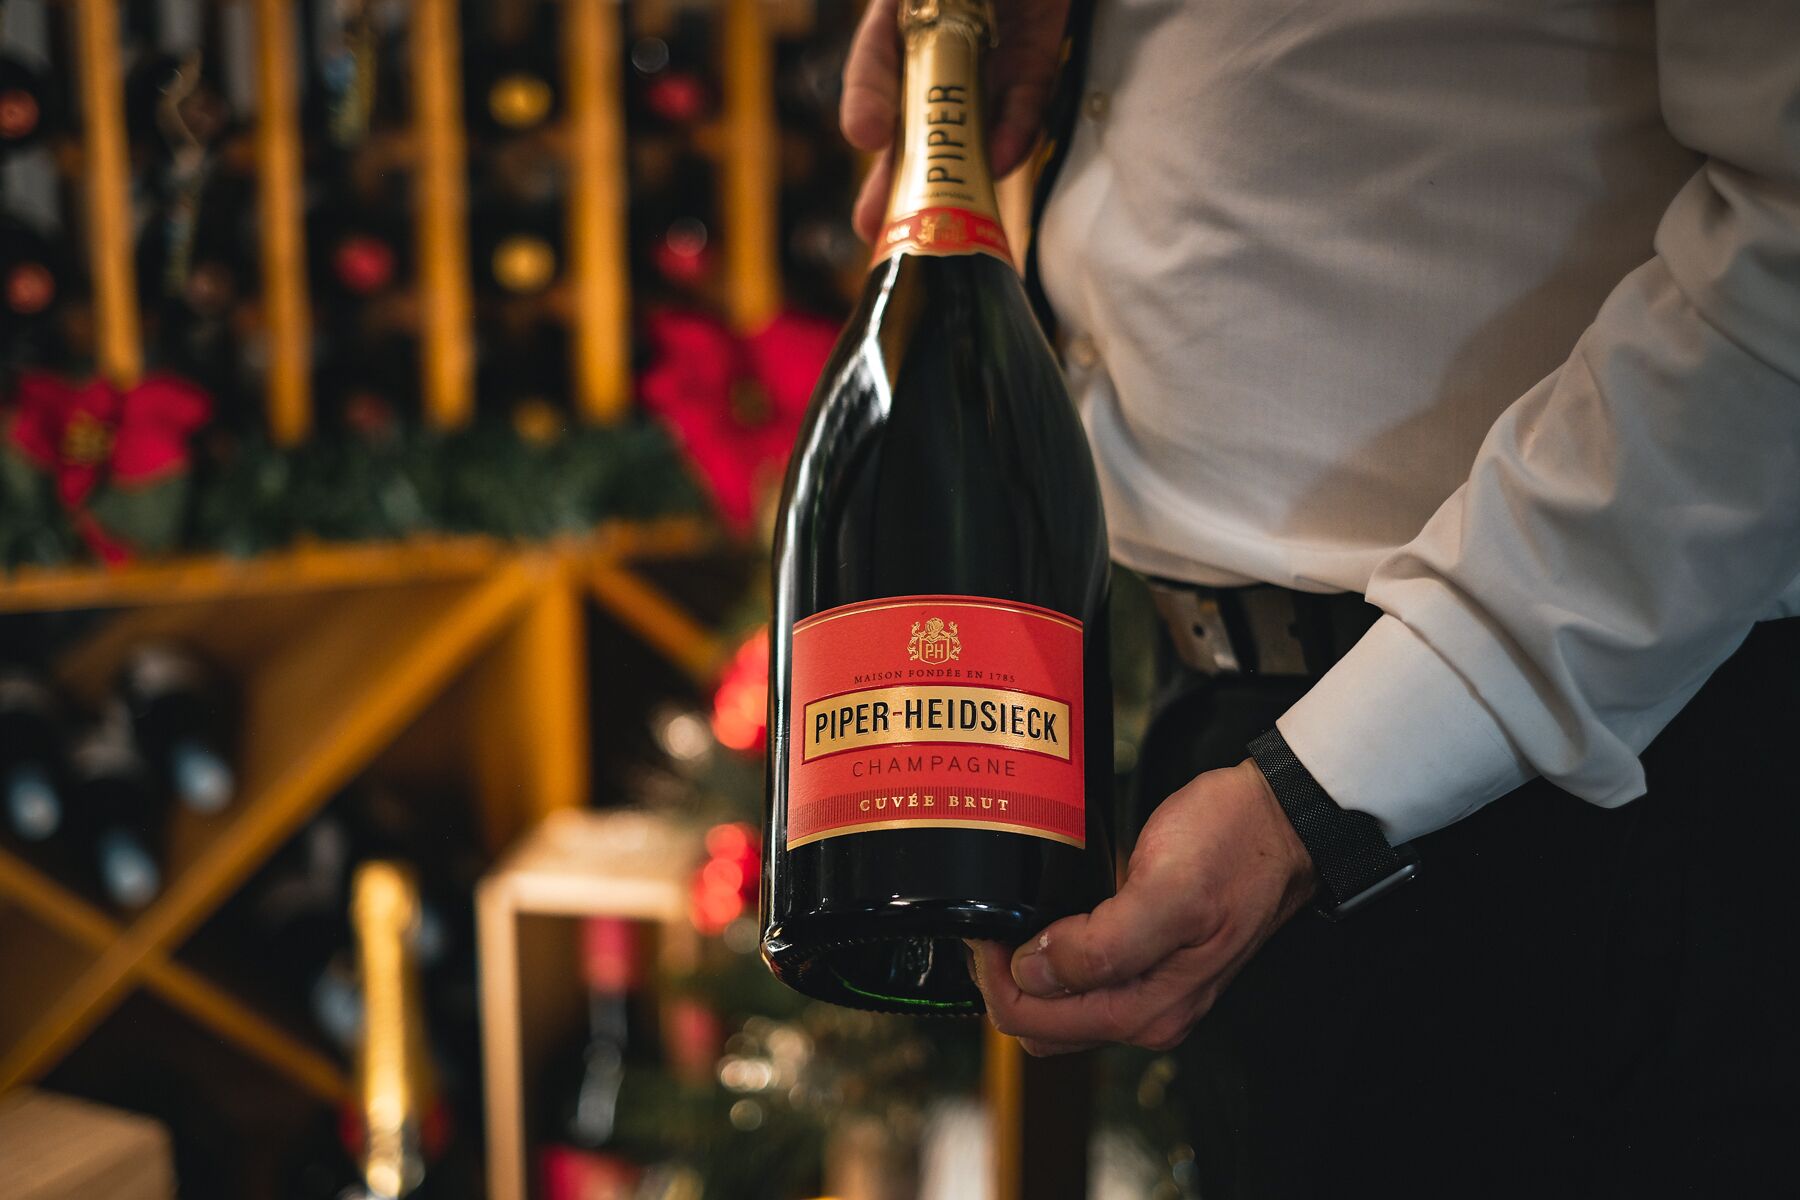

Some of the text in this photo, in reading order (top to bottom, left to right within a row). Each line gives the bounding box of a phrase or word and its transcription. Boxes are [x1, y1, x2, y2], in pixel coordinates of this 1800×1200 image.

[927, 85, 966, 184] PIPER
[854, 667, 1016, 685] MAISON FONDÉE EN 1785
[815, 698, 1058, 745] PIPER-HEIDSIECK
[852, 755, 1016, 778] CHAMPAGNE
[859, 793, 1009, 812] CUVÉE BRUT
